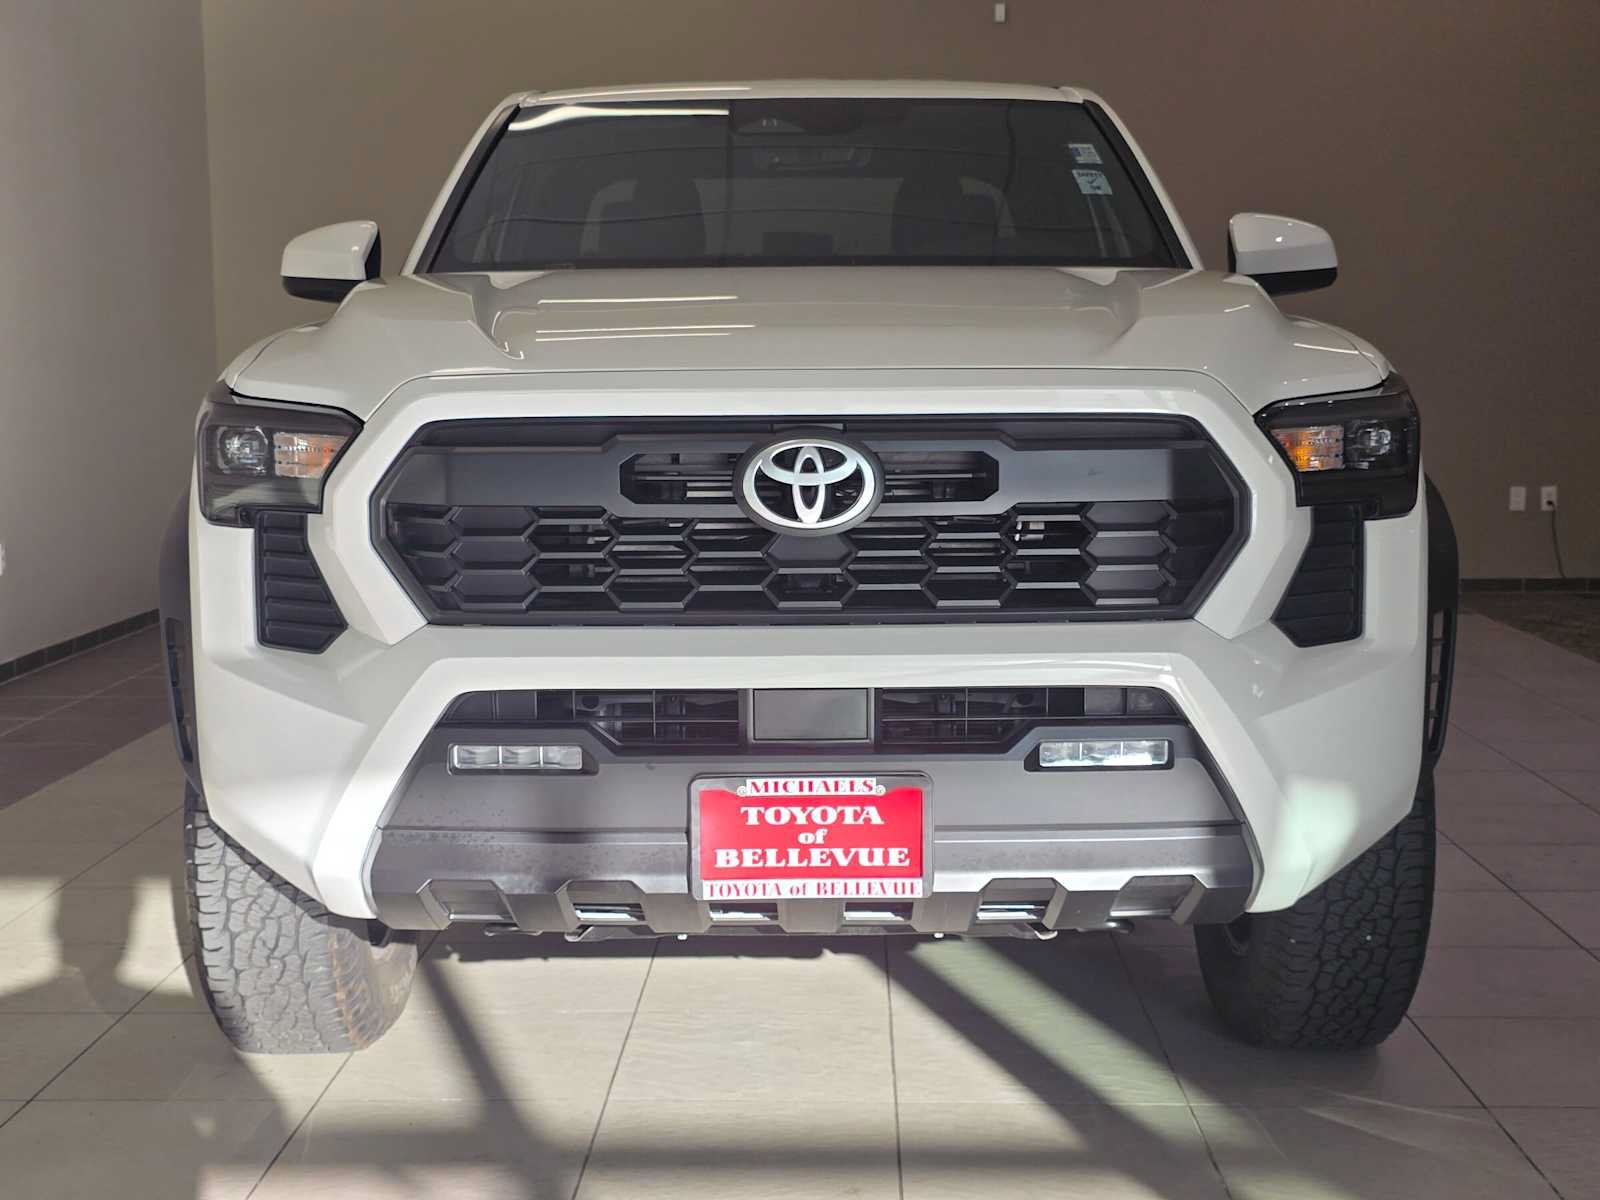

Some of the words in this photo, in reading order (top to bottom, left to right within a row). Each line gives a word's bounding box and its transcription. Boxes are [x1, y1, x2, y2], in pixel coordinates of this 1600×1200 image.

[750, 780, 874, 794] MICHAELS
[739, 806, 885, 825] TOYOTA
[798, 828, 828, 844] of
[715, 848, 911, 868] BELLEVUE
[706, 882, 782, 898] TOYOTA
[789, 882, 809, 897] of
[816, 881, 921, 897] BELLEVUE
